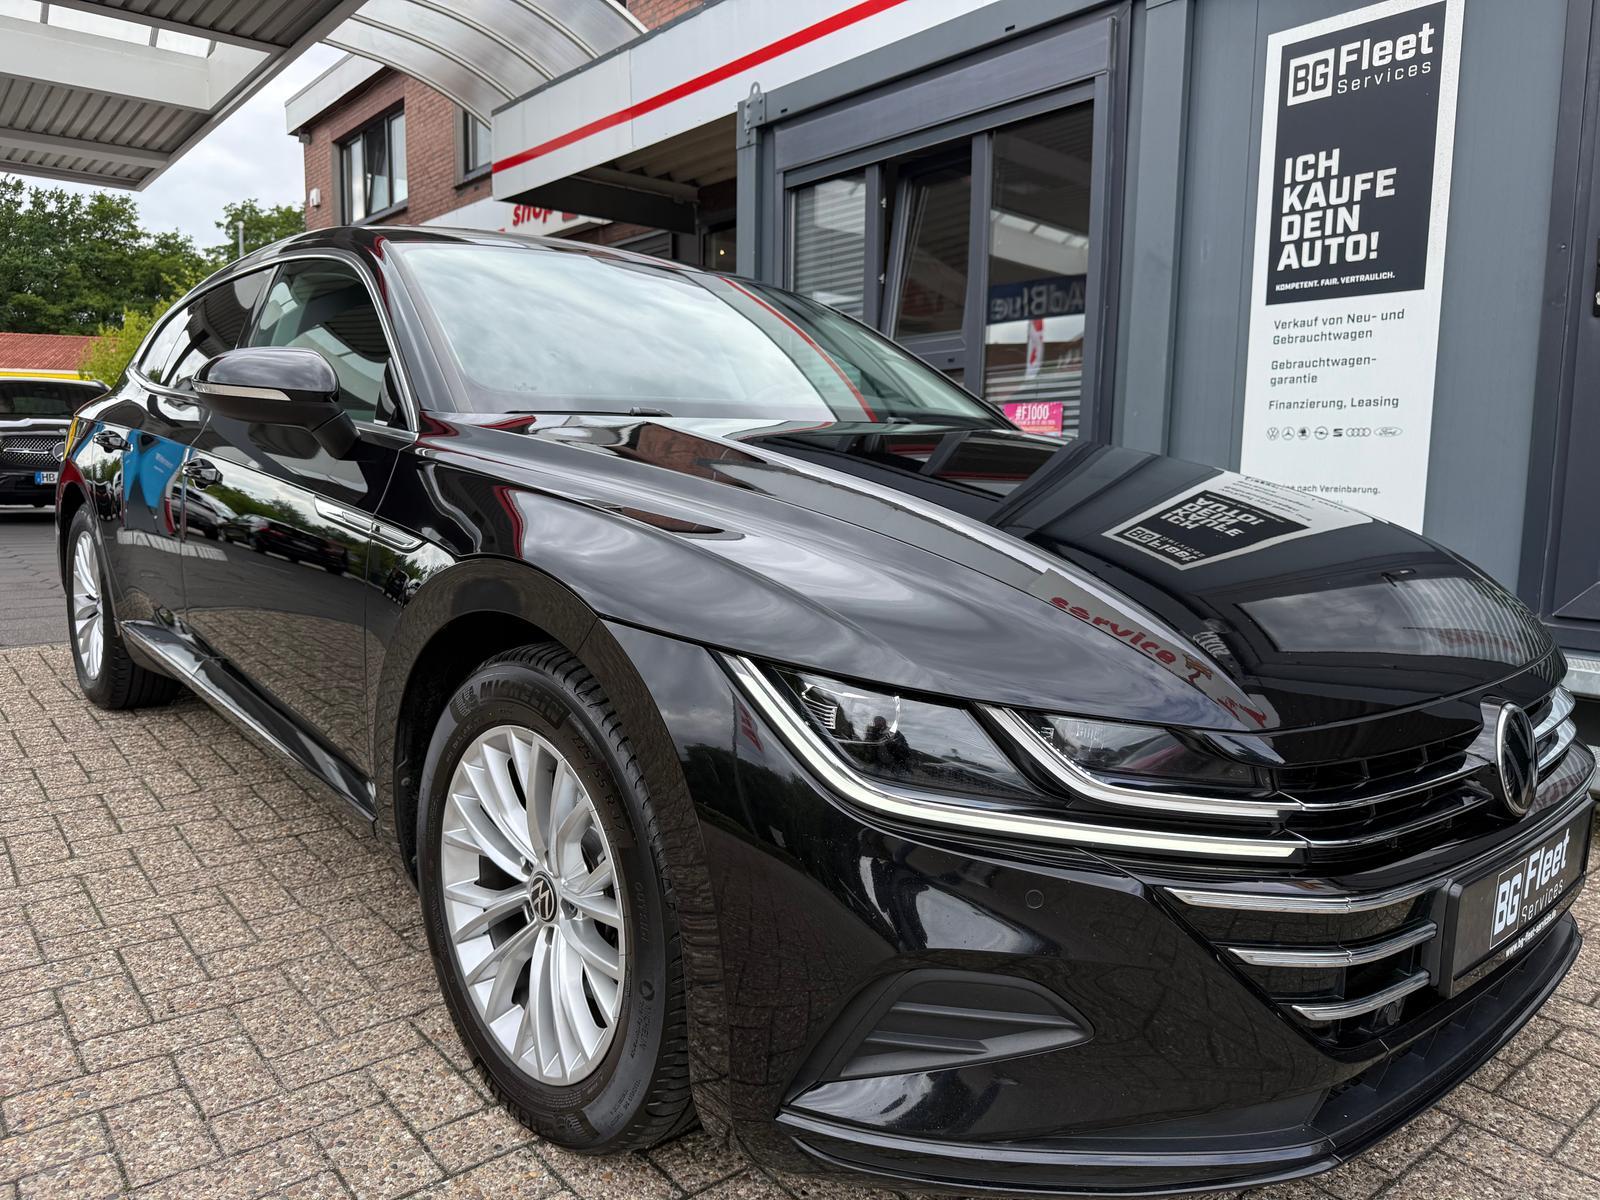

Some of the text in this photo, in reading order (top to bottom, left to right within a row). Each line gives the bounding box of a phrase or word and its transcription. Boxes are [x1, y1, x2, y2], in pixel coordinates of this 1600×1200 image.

[1292, 22, 1435, 98] BG Fleet
[1337, 61, 1431, 94] Services
[1284, 148, 1340, 185] ICH
[1282, 167, 1397, 214] KAUFE
[1280, 204, 1360, 243] DEIN
[1276, 231, 1379, 271] AUTO!
[1275, 271, 1396, 292] KOMPETENT. FAIR. VERTRAULICH.
[1273, 309, 1405, 330] Verkauf von Neu- und
[1272, 328, 1373, 345] Gebrauchtwagen
[1271, 356, 1377, 371] Gebrauchtwagen-
[1270, 373, 1318, 387] garantie
[1015, 405, 1049, 420] #F1000
[1268, 396, 1399, 411] Finanzierung, Leasing
[41, 471, 55, 482] HB
[1300, 484, 1317, 493] nach
[1319, 485, 1381, 495] Vereinbarung.
[1050, 597, 1176, 666] service
[1494, 828, 1570, 936] BG Fleet
[1521, 879, 1564, 922] Services
